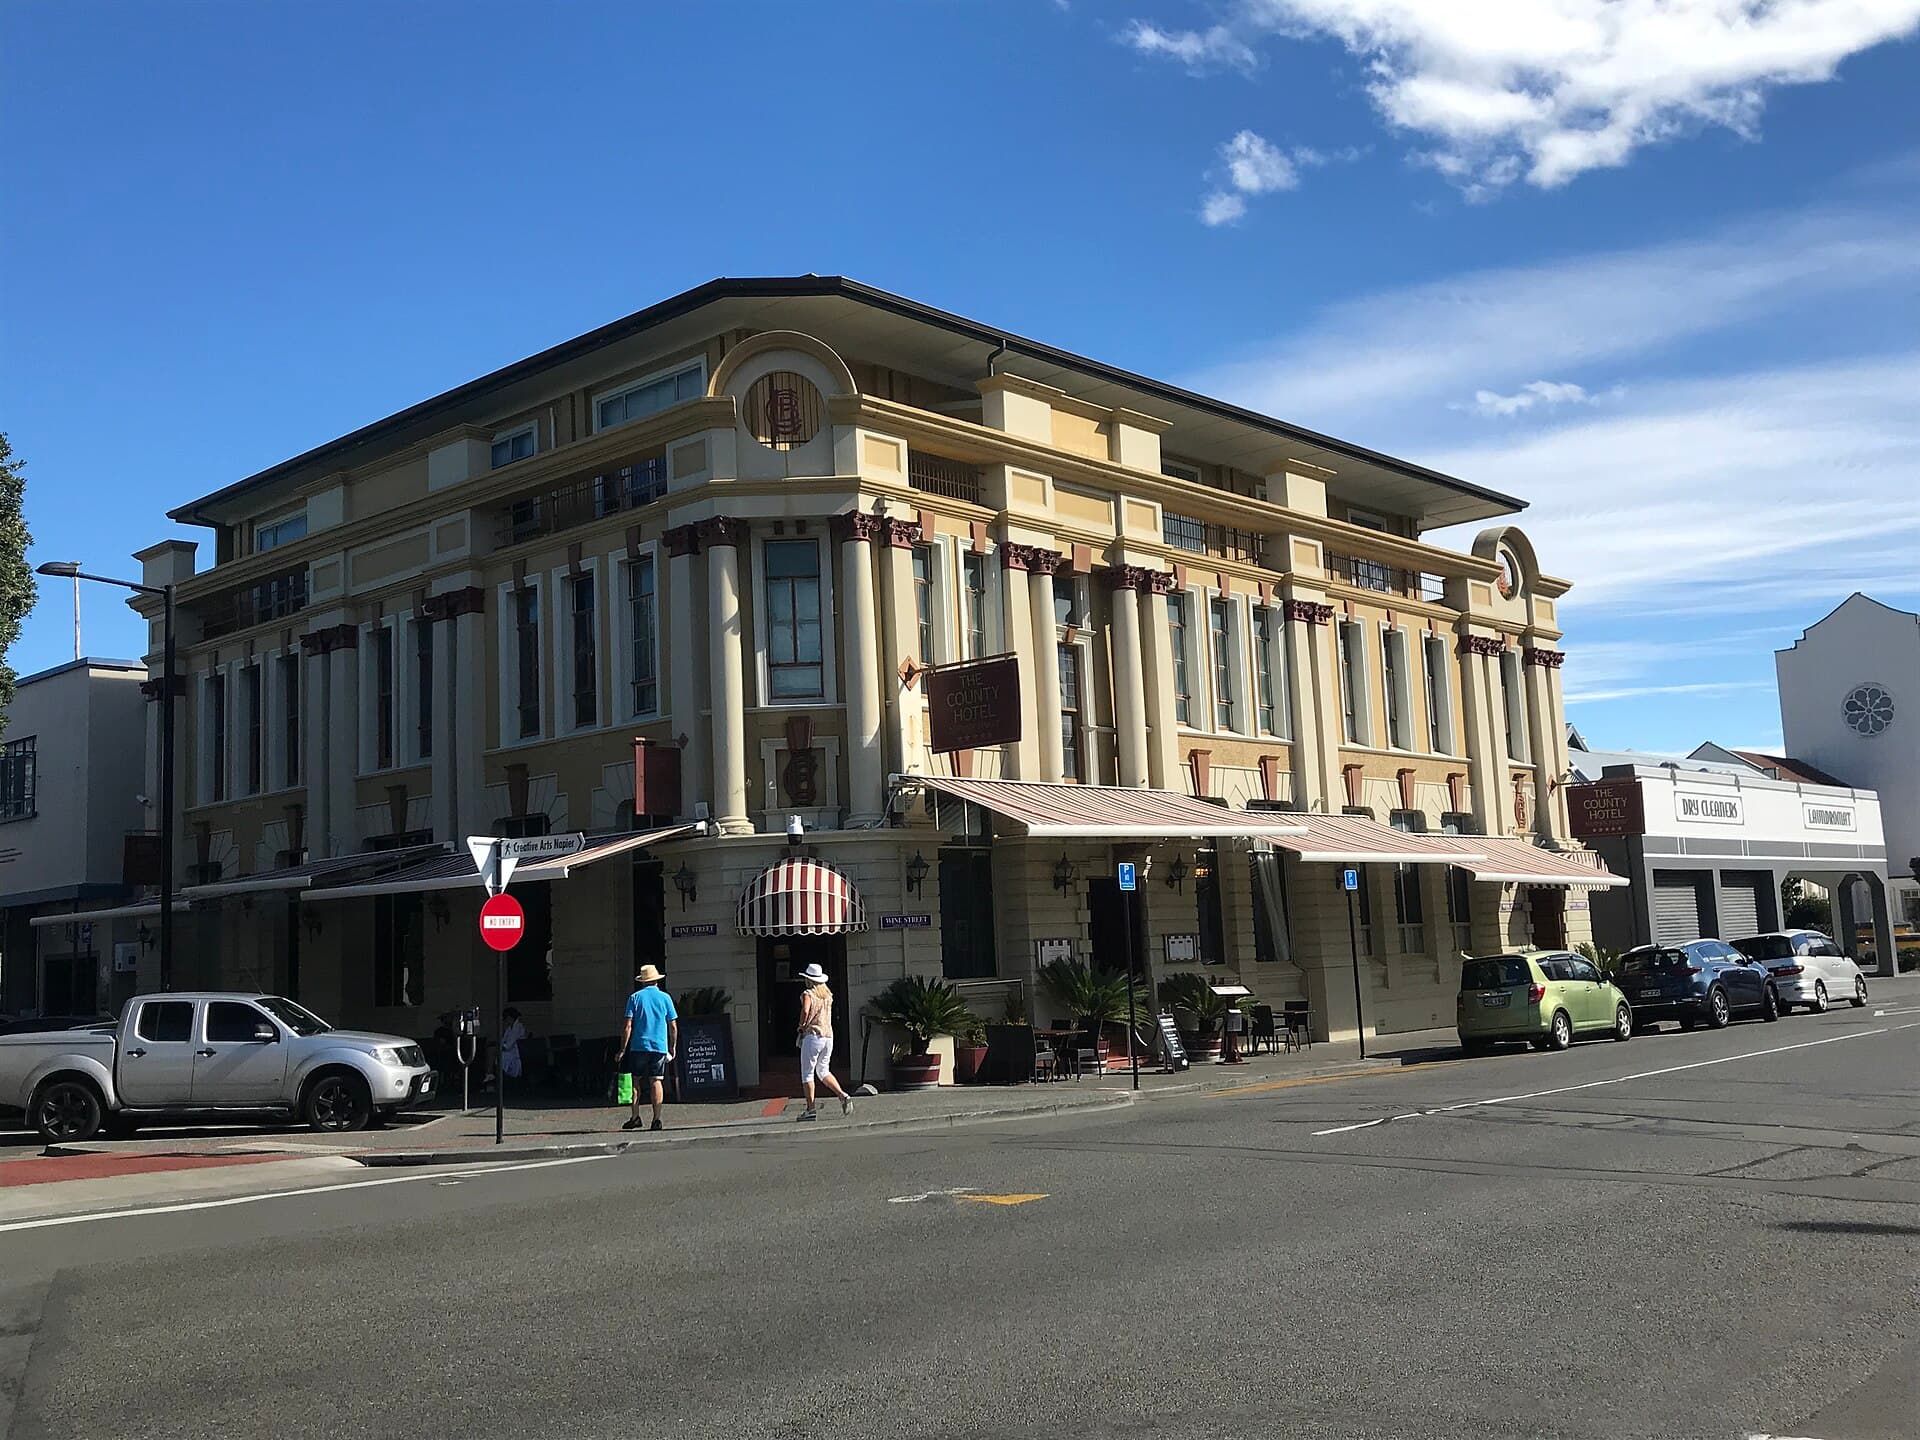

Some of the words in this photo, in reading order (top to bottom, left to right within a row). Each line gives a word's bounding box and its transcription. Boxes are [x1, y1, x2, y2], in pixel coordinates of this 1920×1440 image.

[960, 673, 983, 688] THE
[946, 685, 999, 707] COUNTY
[954, 704, 996, 723] HOTEL
[1594, 788, 1614, 798] THE
[1583, 797, 1627, 809] COUNTY
[1682, 798, 1698, 816] DRY
[1701, 799, 1738, 819] CLEANERS
[1589, 808, 1625, 820] HOTEL
[1808, 808, 1852, 826] LAUNDROMAT
[513, 841, 538, 853] Creative
[540, 839, 552, 851] Arts
[553, 839, 575, 851] Napier
[1123, 865, 1130, 874] P
